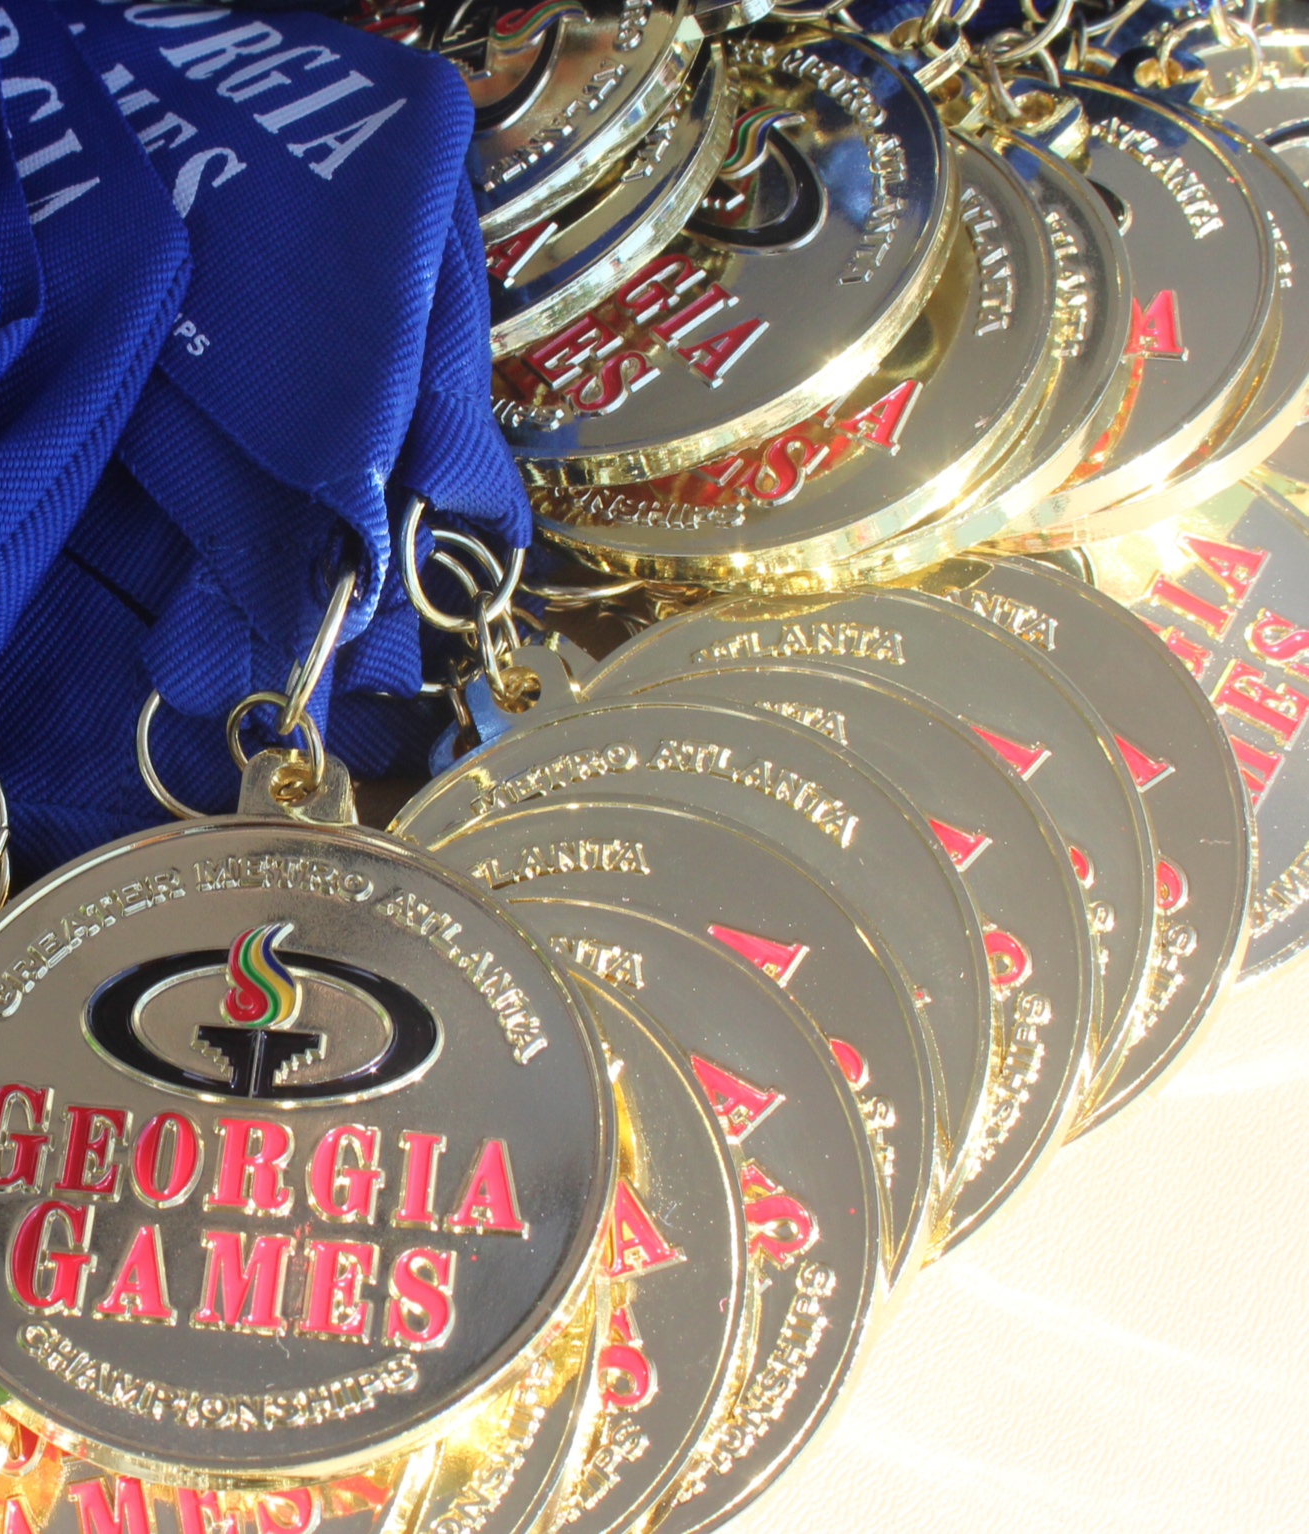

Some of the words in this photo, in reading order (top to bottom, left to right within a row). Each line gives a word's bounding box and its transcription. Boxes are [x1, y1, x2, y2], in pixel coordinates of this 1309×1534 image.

[837, 132, 908, 286] ATLANTA
[470, 742, 638, 815] METRO
[645, 738, 861, 850] ATLANTA
[194, 855, 375, 902] METRO
[376, 890, 549, 1067] ATLANTA
[5, 1194, 458, 1352] GAMES
[16, 1320, 420, 1430] CHAMPIONSHIPS
